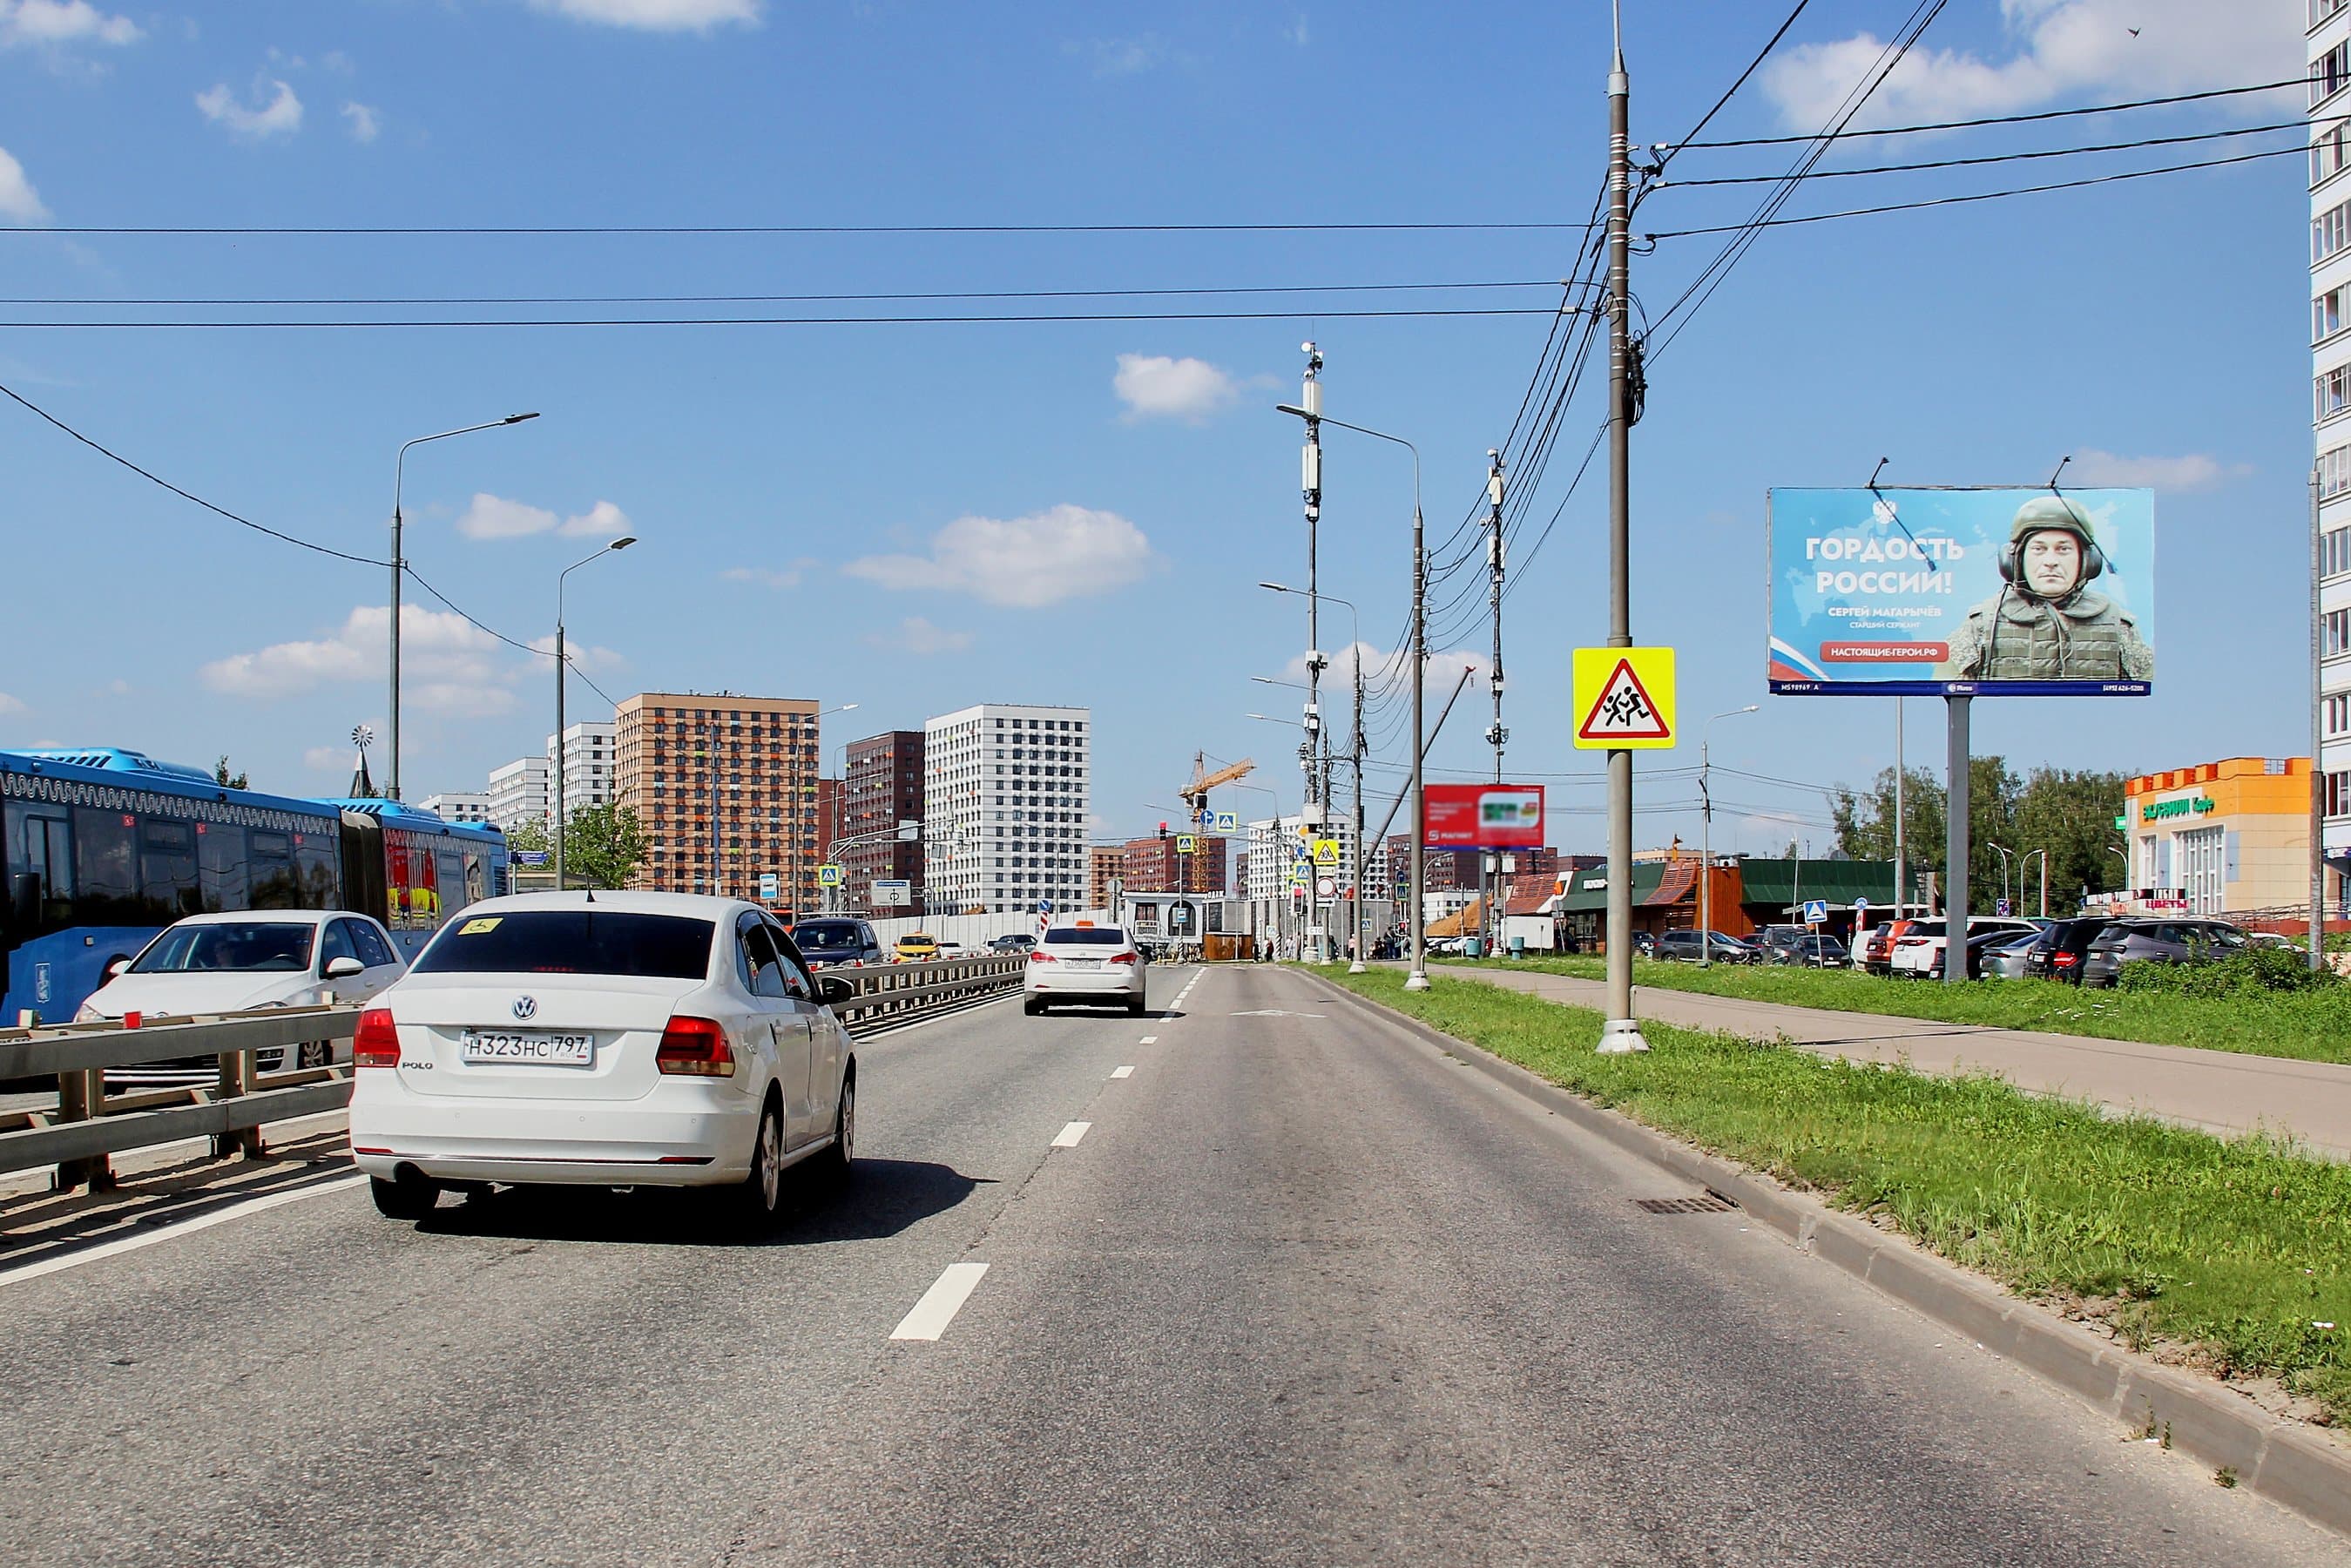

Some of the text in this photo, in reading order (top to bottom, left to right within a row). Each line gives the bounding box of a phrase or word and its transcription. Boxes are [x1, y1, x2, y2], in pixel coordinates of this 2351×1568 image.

[1806, 537, 1965, 564] ГОРДОСТЬ
[1816, 571, 1952, 594] РОССИИ!
[1827, 605, 1942, 618] СЕРГЕЙ МАГАРЫЧЁВ
[1830, 647, 1938, 658] НАСТОЯЩИЕ-ГЕРОИ.РФ
[554, 1036, 587, 1053] 797
[402, 1062, 434, 1071] POLO
